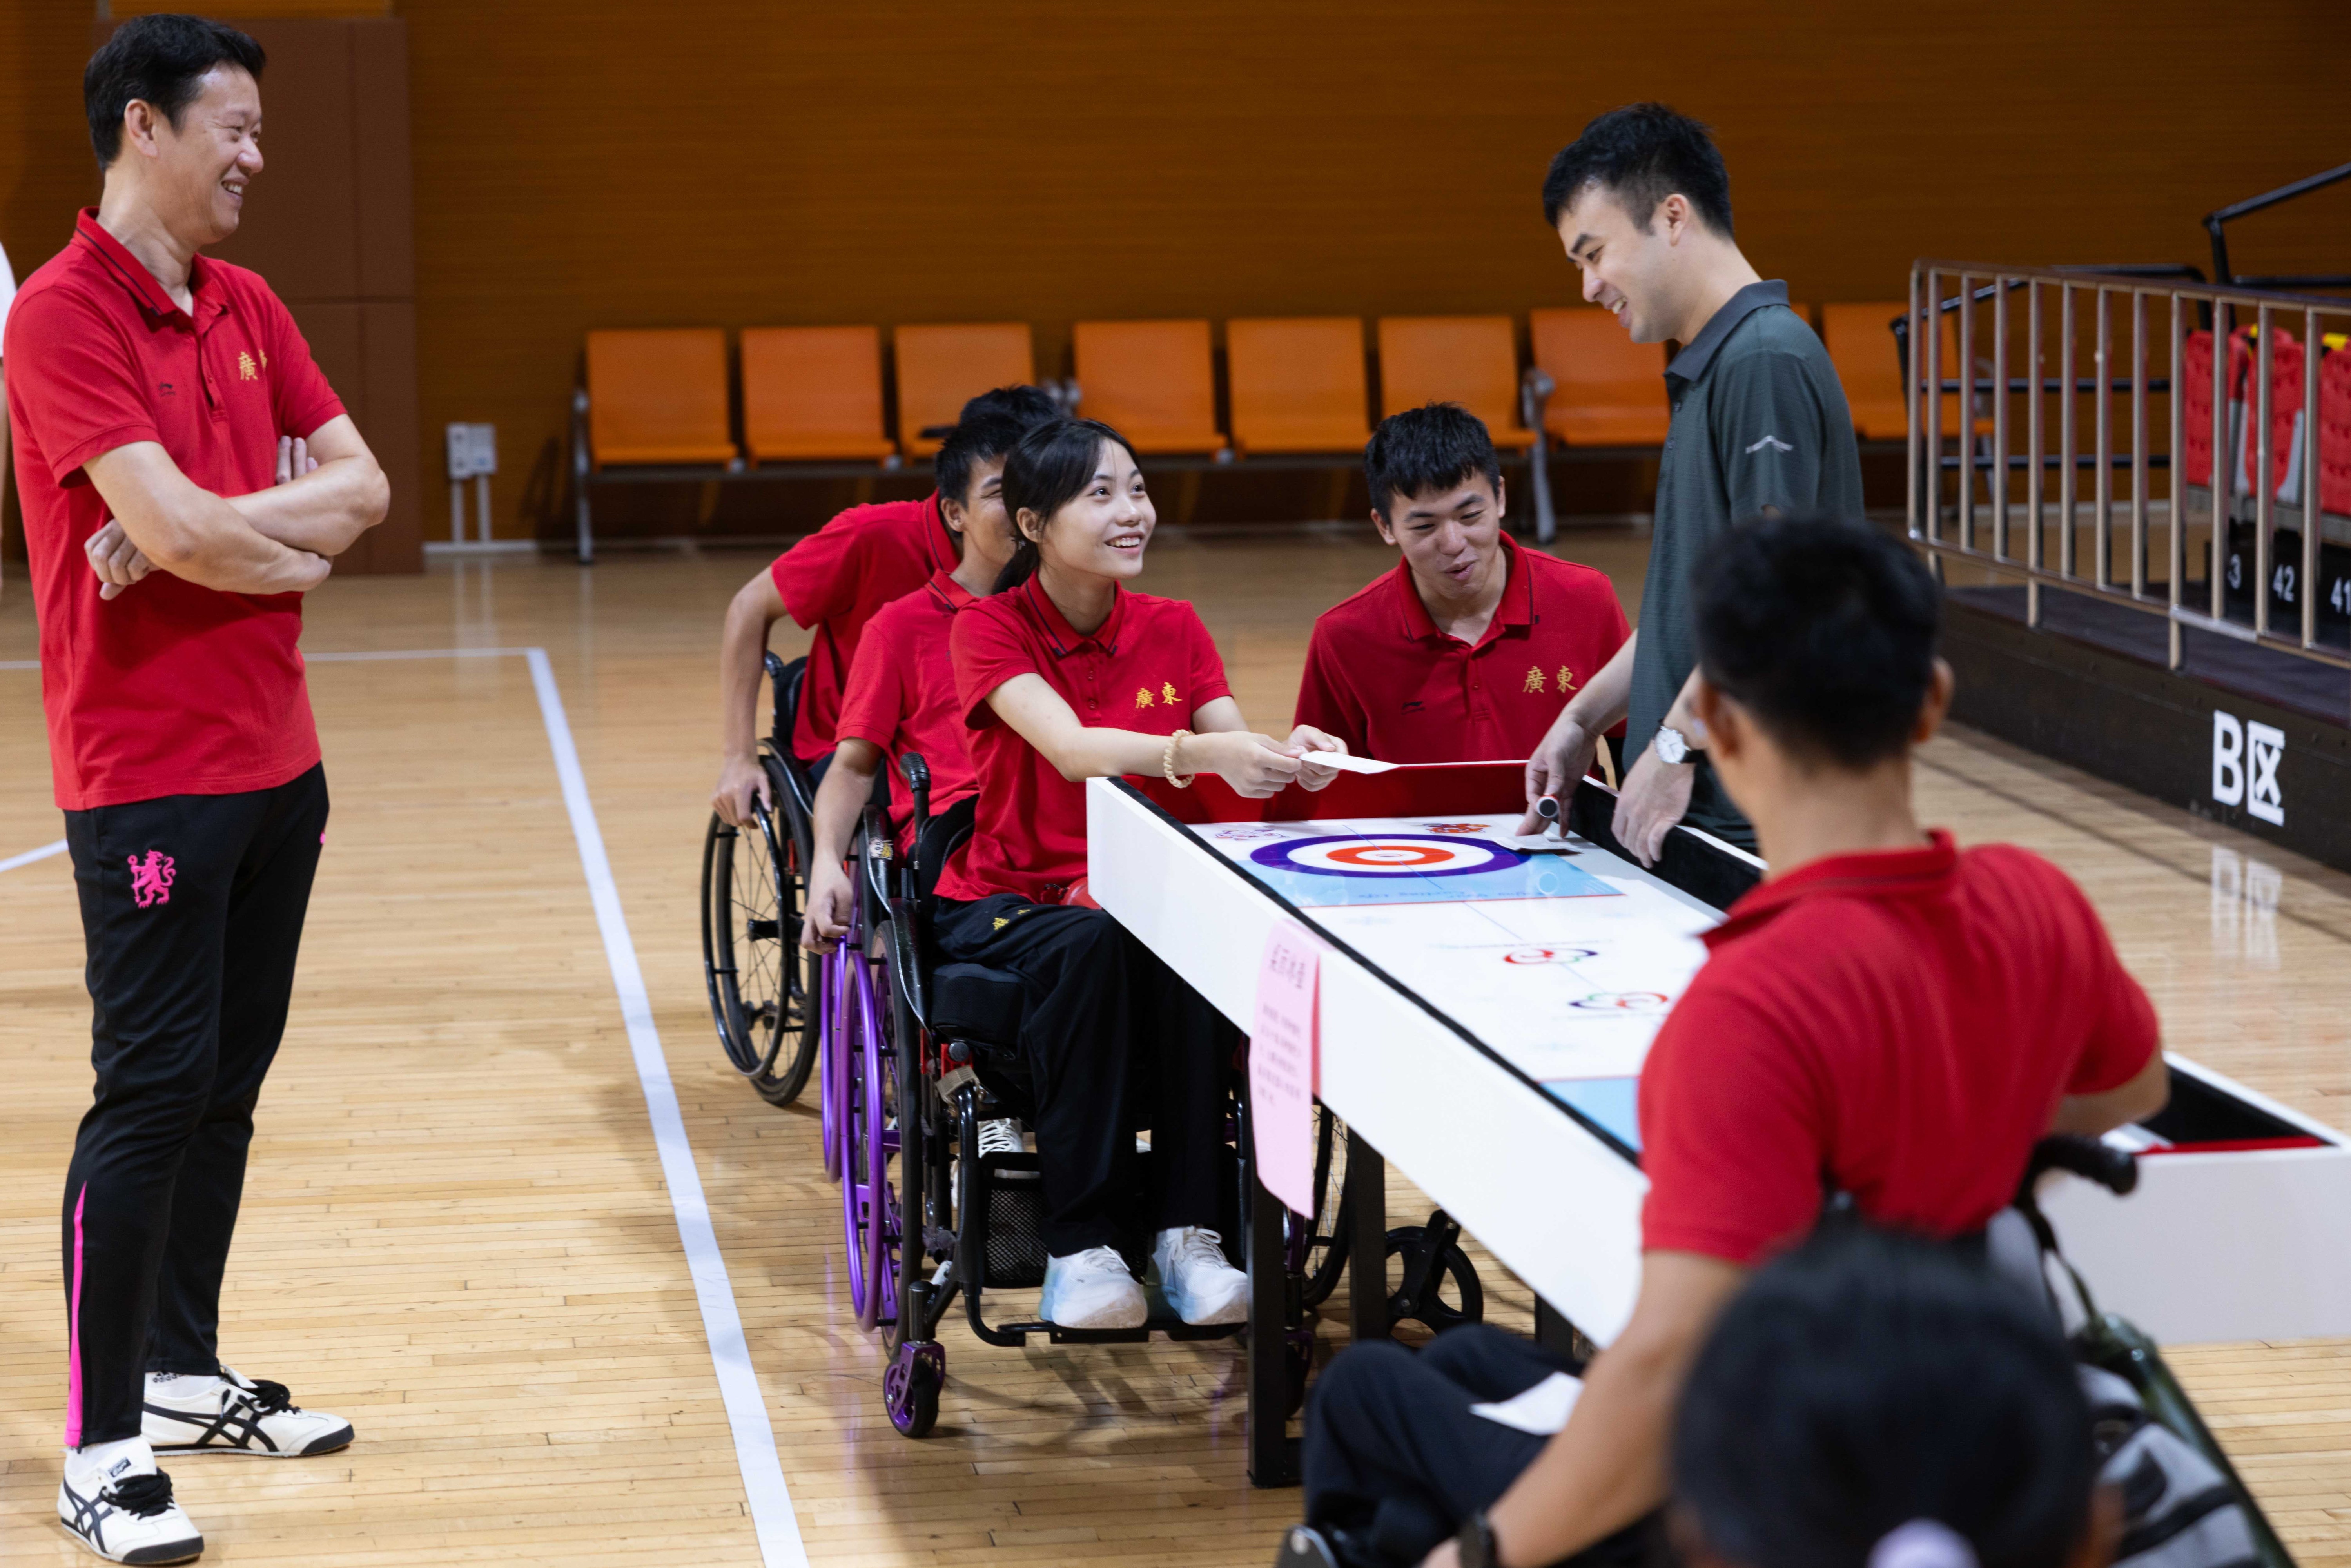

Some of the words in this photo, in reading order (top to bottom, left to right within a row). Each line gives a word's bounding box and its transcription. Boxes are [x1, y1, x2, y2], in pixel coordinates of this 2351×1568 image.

[2273, 564, 2295, 602] 42
[1522, 665, 1577, 693] 廣東
[1135, 682, 1182, 709] 廣東
